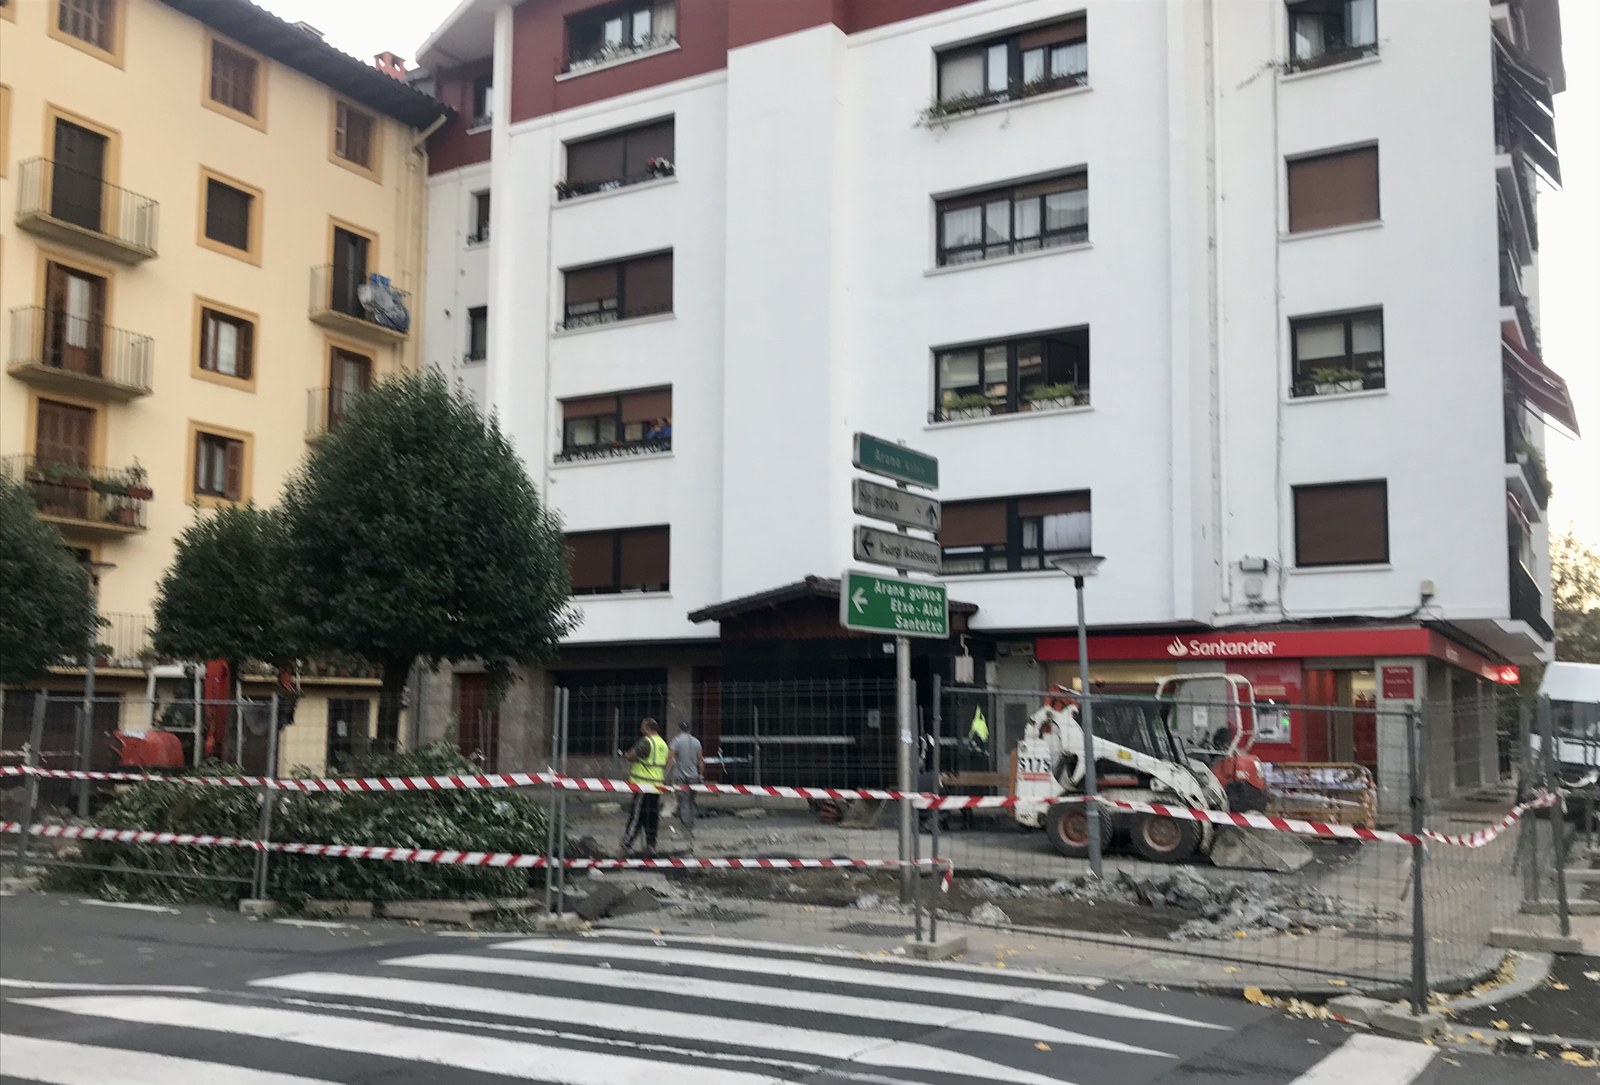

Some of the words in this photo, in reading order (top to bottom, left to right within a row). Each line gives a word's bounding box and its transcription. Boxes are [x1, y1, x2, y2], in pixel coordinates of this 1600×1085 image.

[873, 579, 906, 598] Arana
[908, 586, 943, 602] goikoa
[890, 597, 915, 615] Etxe
[922, 601, 943, 618] Alai
[894, 613, 943, 633] Santutxo
[1189, 639, 1276, 656] Santander
[1018, 757, 1051, 773] S175
